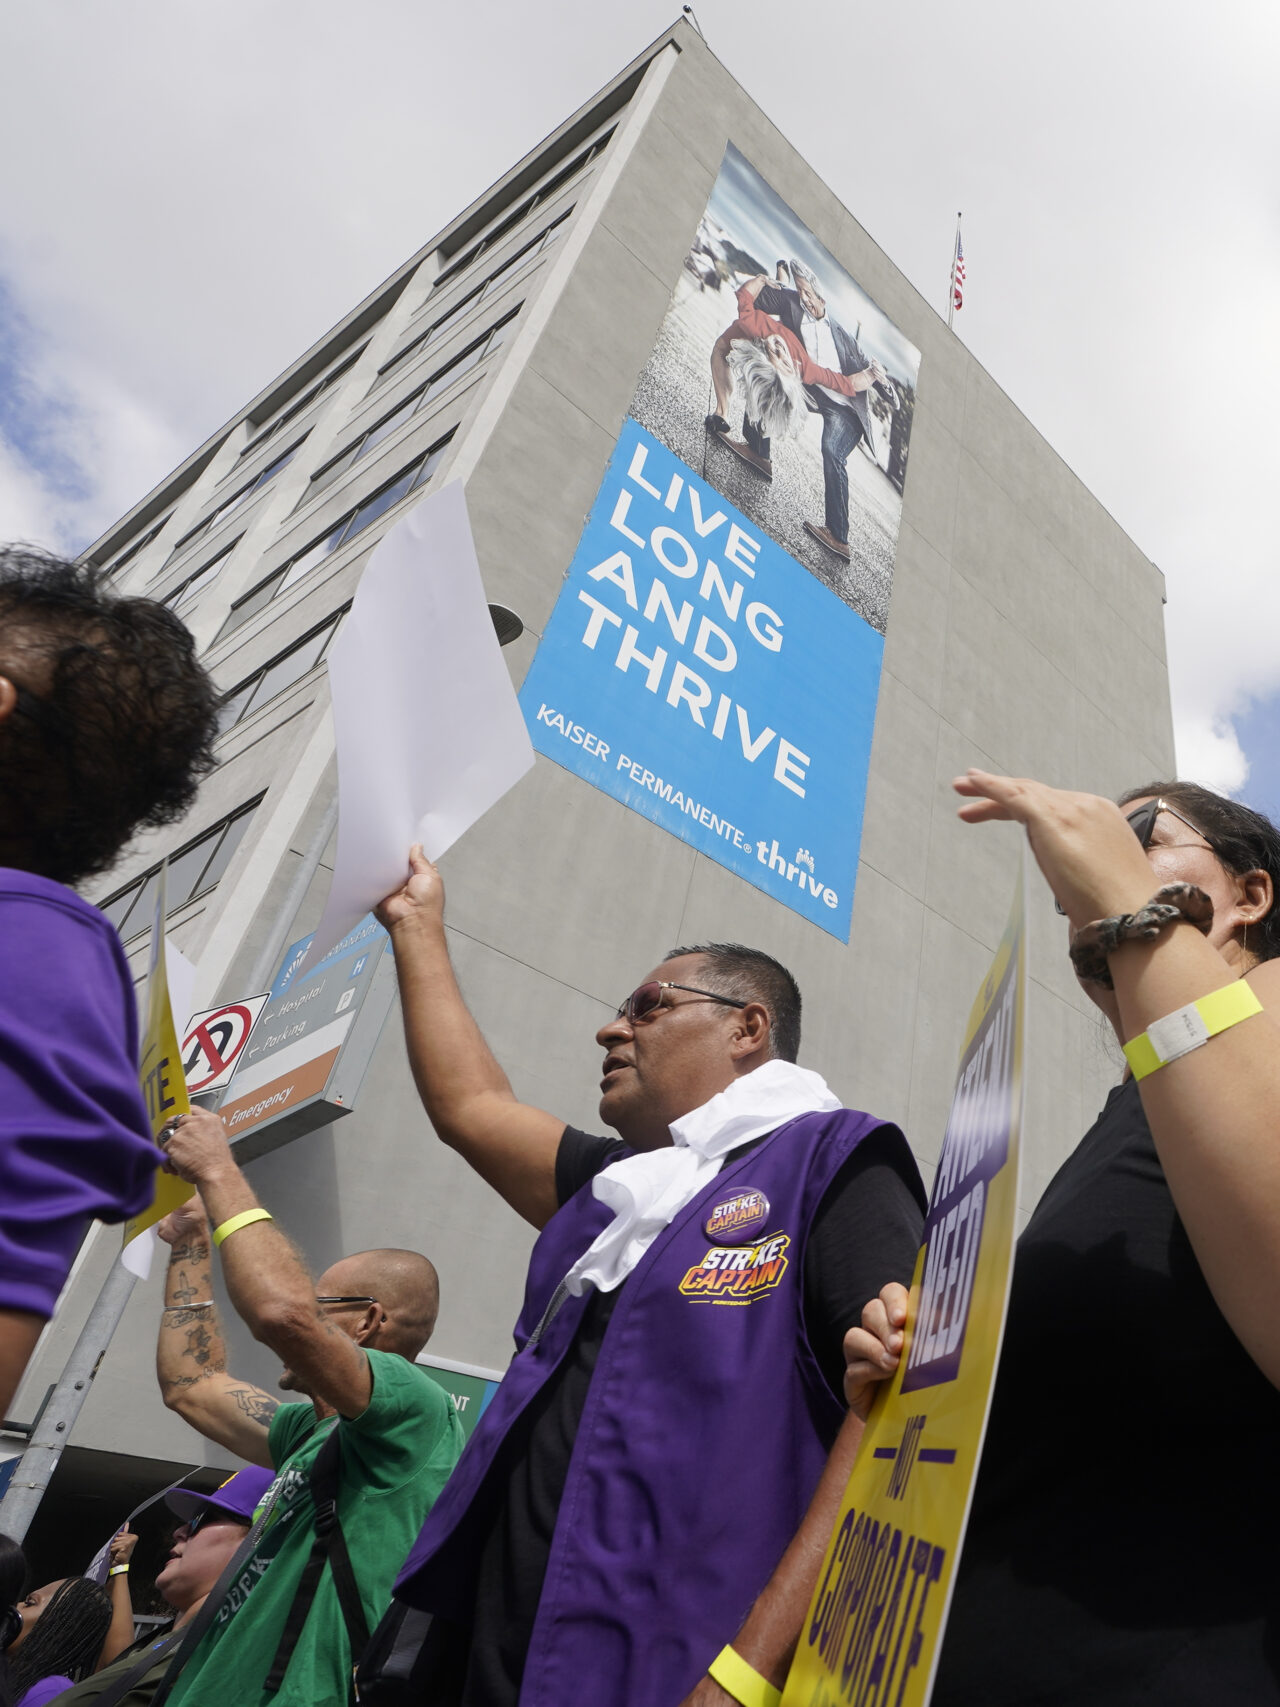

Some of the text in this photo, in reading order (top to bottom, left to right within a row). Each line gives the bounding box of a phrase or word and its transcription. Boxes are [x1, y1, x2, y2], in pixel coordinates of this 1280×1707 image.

[627, 442, 762, 579] LIVE
[609, 488, 785, 653] LONG
[587, 550, 738, 673] AND
[578, 590, 812, 799] THRIVE
[537, 703, 611, 763] KAISER
[756, 839, 839, 909] thrive
[279, 978, 326, 1018] Hospital
[263, 1020, 307, 1052] Parking
[228, 1085, 296, 1127] Emergency
[706, 1204, 761, 1232] CAPTAIN
[714, 1194, 760, 1219] STRIKE
[682, 1258, 783, 1291] CAPTAIN
[702, 1238, 785, 1271] STRIKE
[908, 1179, 985, 1371] NEED
